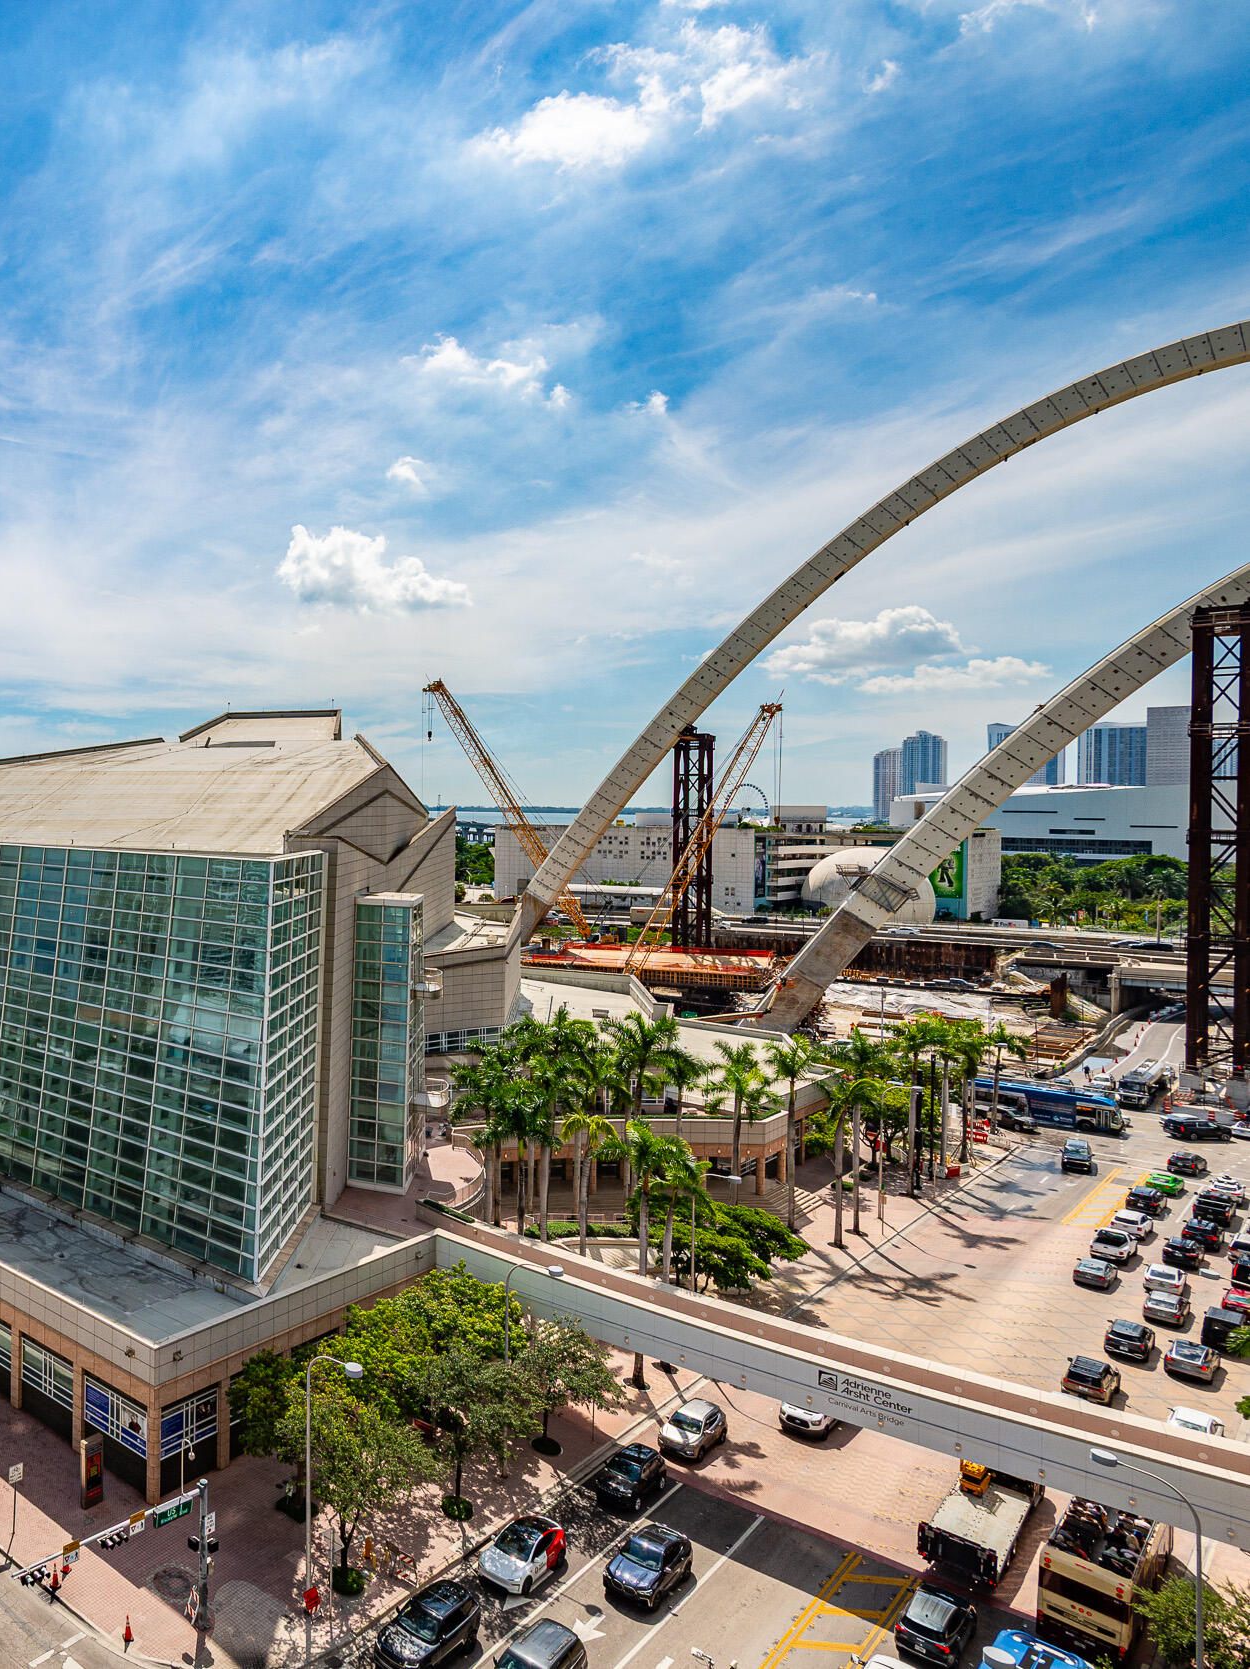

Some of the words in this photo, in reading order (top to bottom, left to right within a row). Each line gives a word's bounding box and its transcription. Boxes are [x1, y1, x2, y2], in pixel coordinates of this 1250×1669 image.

[841, 1378, 892, 1400] Adrienne
[841, 1387, 871, 1402] Arsht
[873, 1396, 913, 1414] Center
[828, 1397, 859, 1412] Carnival
[859, 1407, 876, 1418] Arts
[878, 1412, 905, 1426] Bridge
